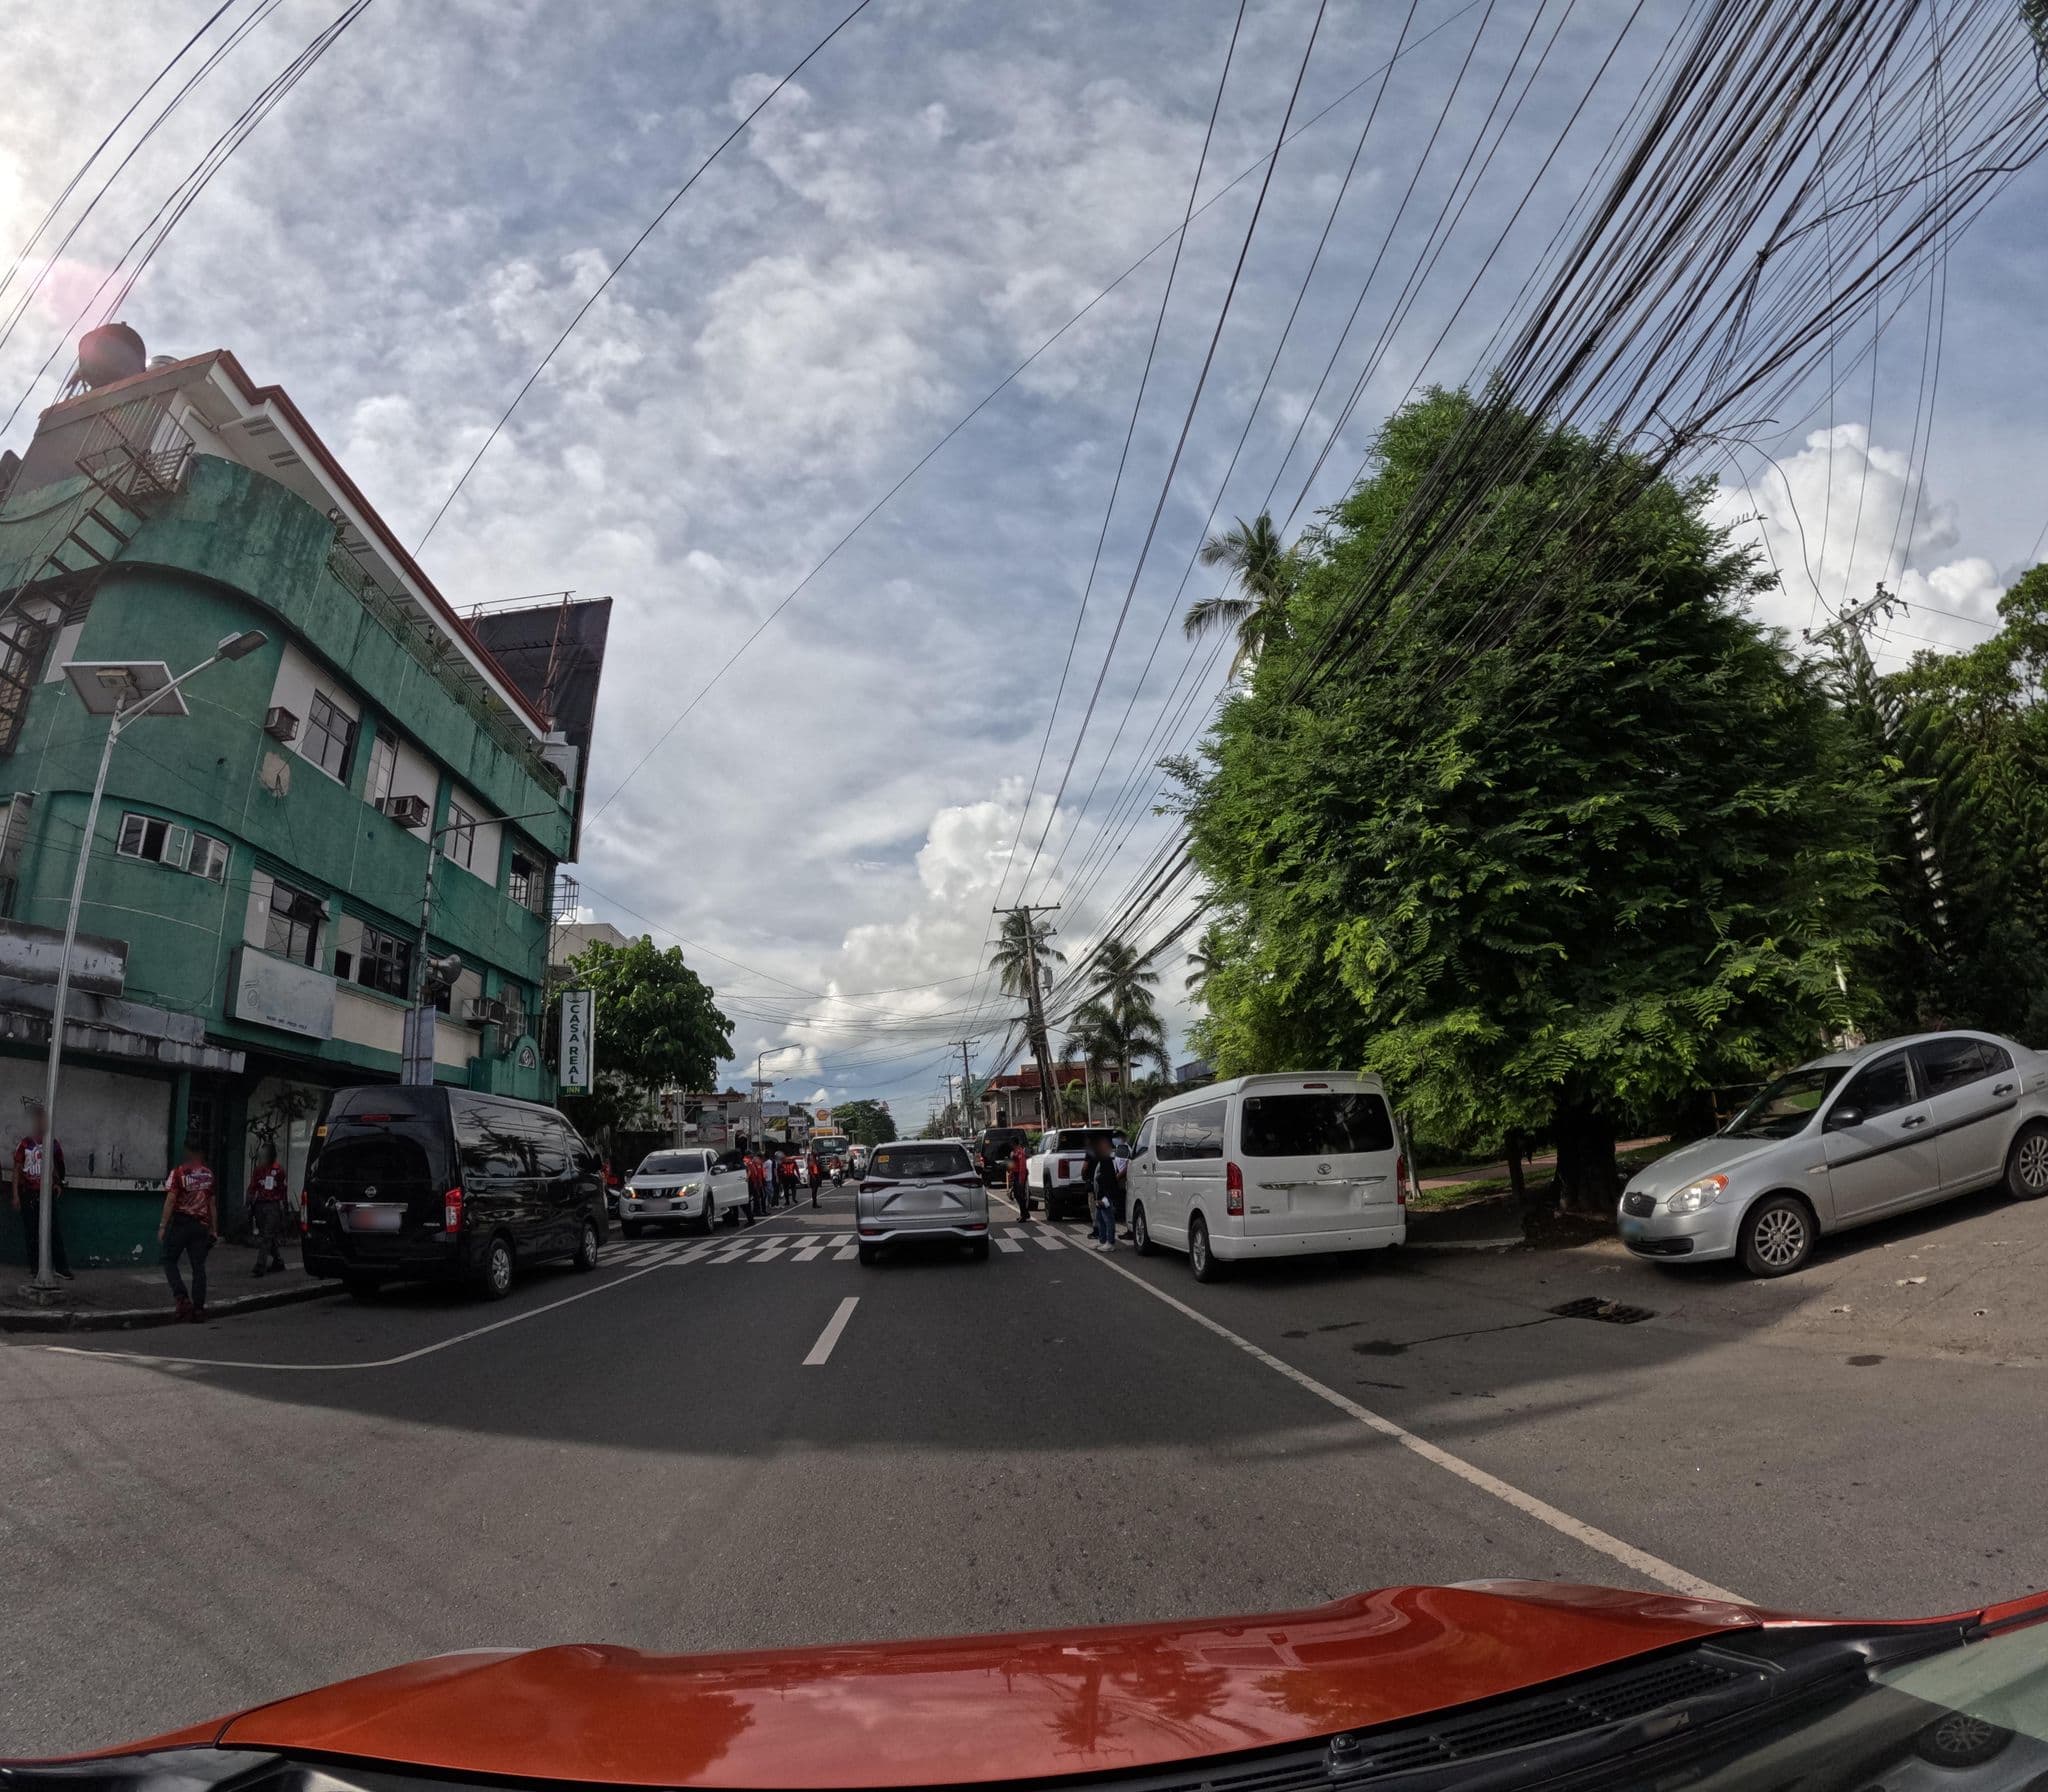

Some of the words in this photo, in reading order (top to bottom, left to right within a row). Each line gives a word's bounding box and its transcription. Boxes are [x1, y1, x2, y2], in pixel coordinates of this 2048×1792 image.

[568, 1004, 580, 1042] CASA
[568, 1046, 579, 1084] REAL
[566, 1086, 580, 1094] INN
